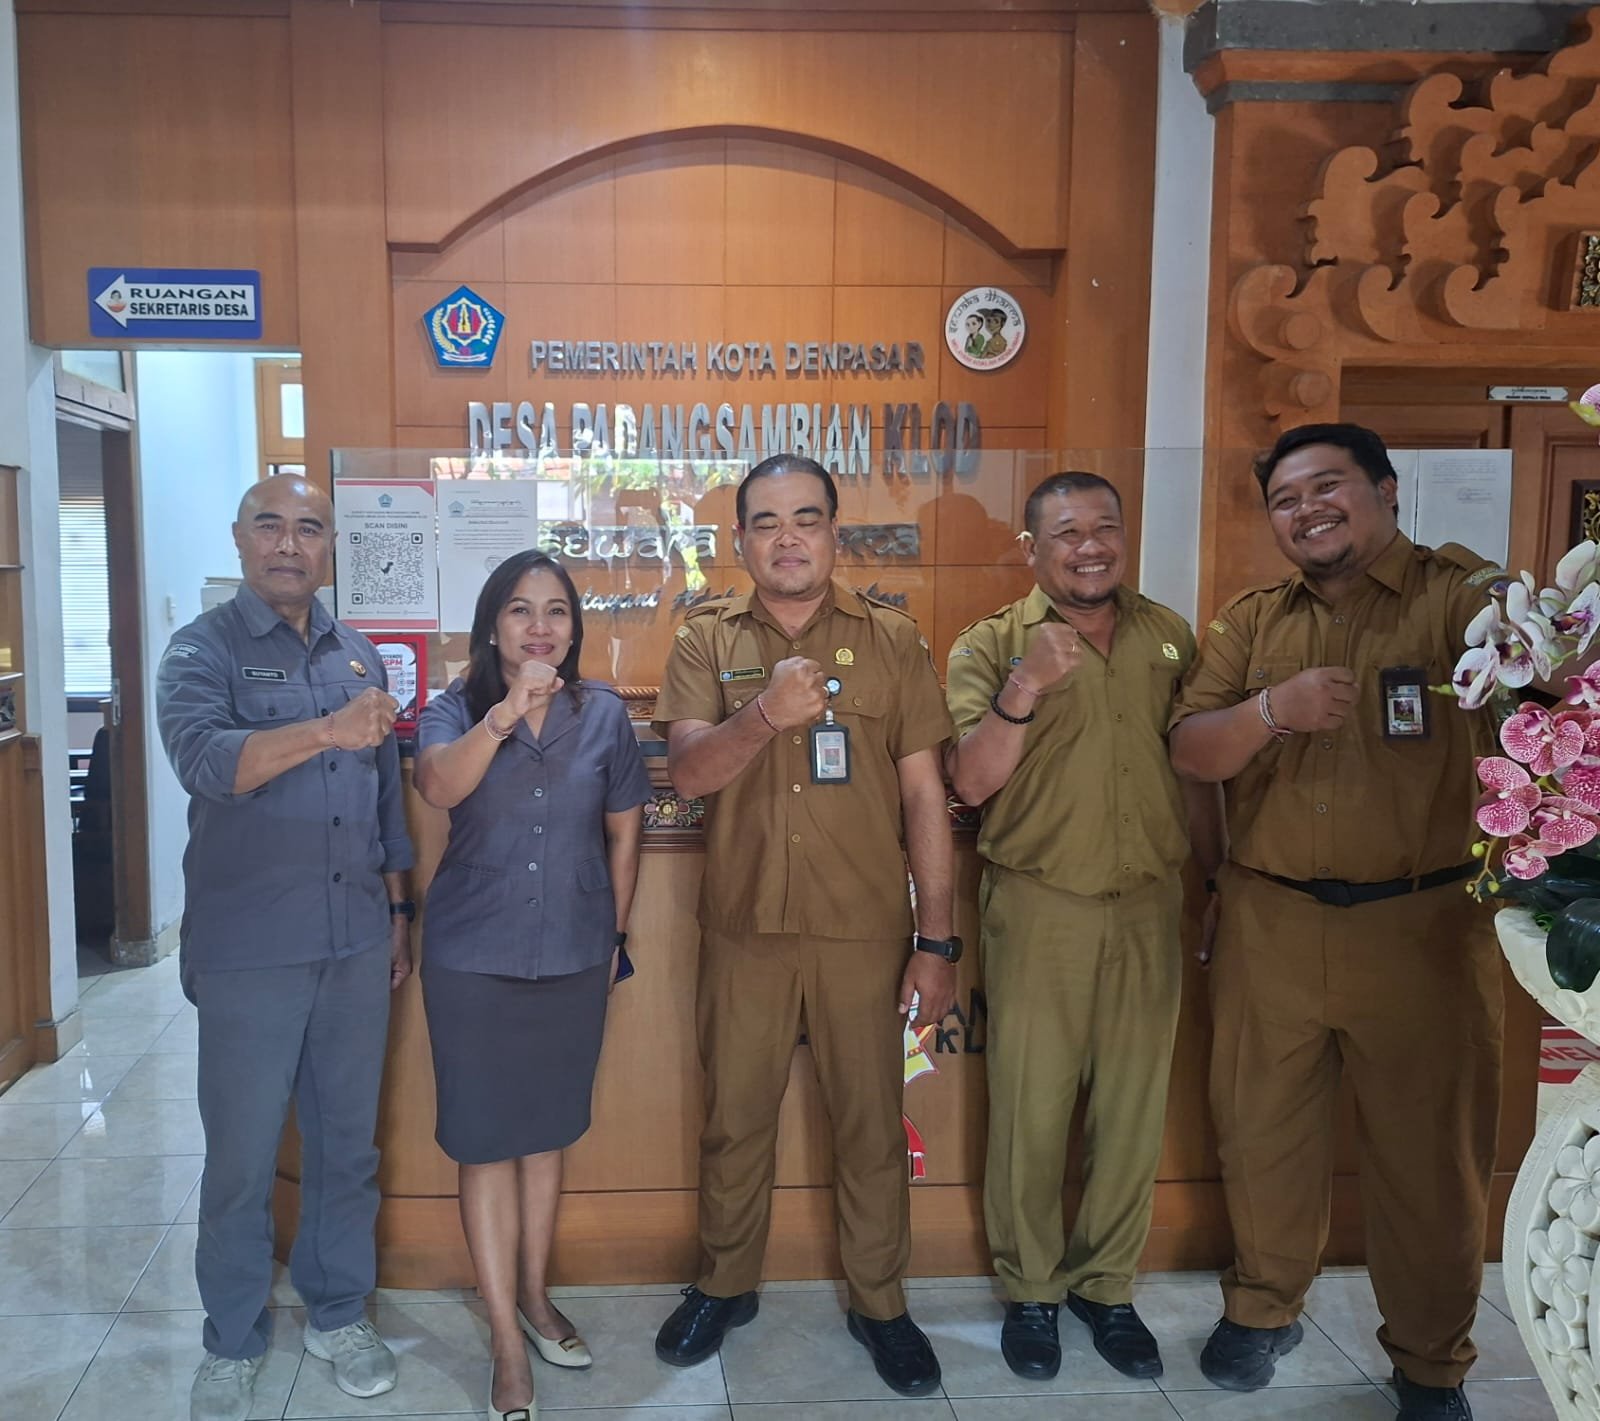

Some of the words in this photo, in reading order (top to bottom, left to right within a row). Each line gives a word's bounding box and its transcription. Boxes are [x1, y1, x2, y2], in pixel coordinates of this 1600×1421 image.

[130, 288, 246, 300] RUANGAN
[130, 302, 210, 316] SEKRETARIS
[214, 303, 249, 317] DESA
[530, 340, 697, 371] PEMERINTAH
[705, 341, 777, 372] KOTA
[784, 341, 925, 371] DENPASAR
[467, 401, 557, 468] DESA
[571, 402, 871, 475] PADANGSAMBIAN
[883, 402, 981, 474] KLOD
[935, 1027, 988, 1054] KL
